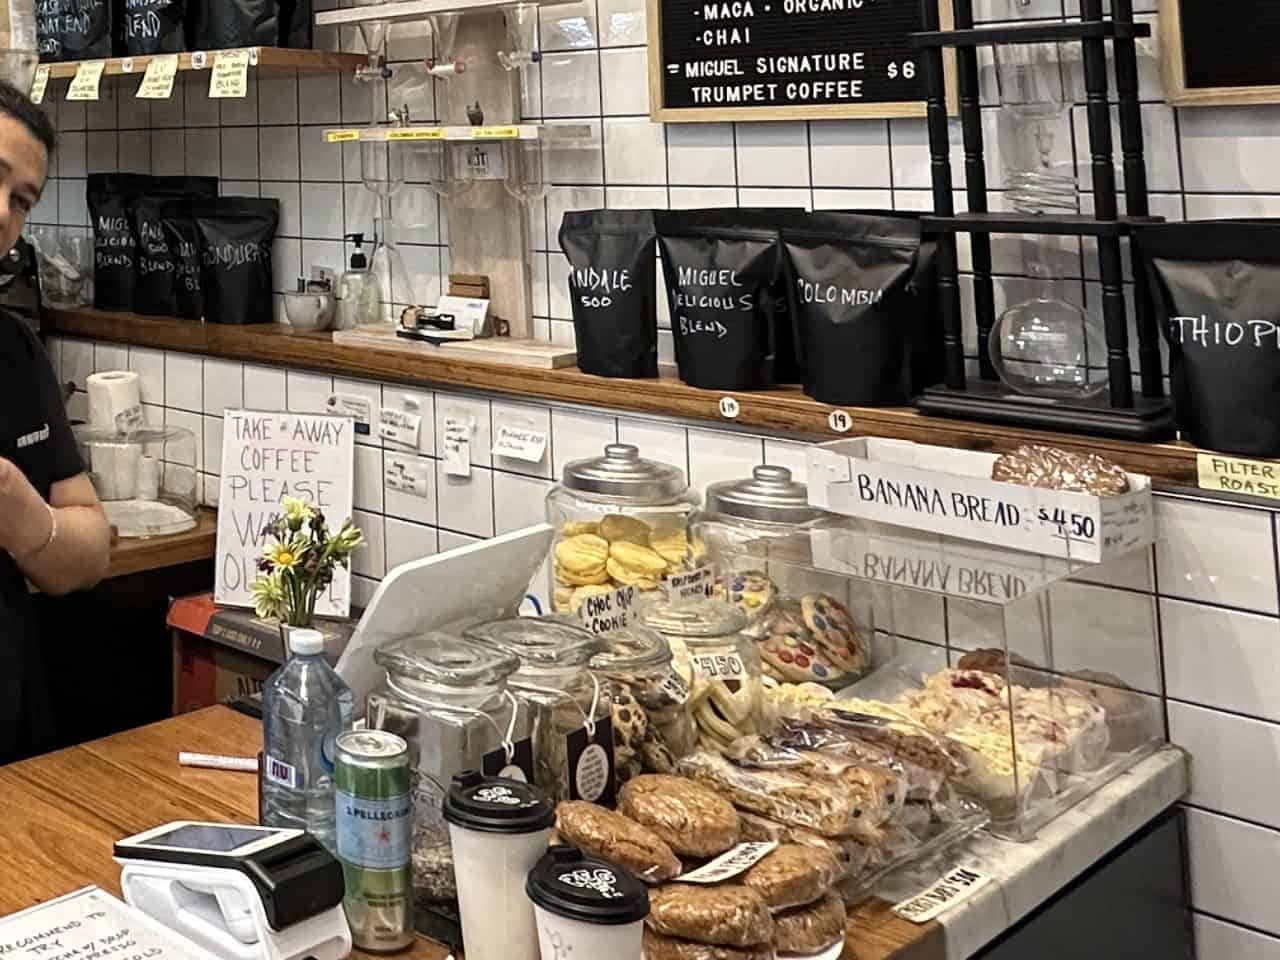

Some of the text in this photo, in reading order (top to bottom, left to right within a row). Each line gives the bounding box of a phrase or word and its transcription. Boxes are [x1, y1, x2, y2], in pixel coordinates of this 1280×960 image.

[685, 59, 744, 79] MIGUEL
[755, 52, 865, 74] SIGNATURE
[691, 79, 863, 104] TRUMPET COFFEE
[678, 266, 744, 287] MIGUEL
[679, 315, 728, 339] BLEND
[232, 416, 345, 447] TAKE AWAY
[240, 445, 321, 473] COFFEE
[1211, 458, 1275, 479] FILTER
[227, 474, 334, 508] PLEASE
[857, 473, 947, 517] BANANA
[1220, 477, 1280, 497] ROAST
